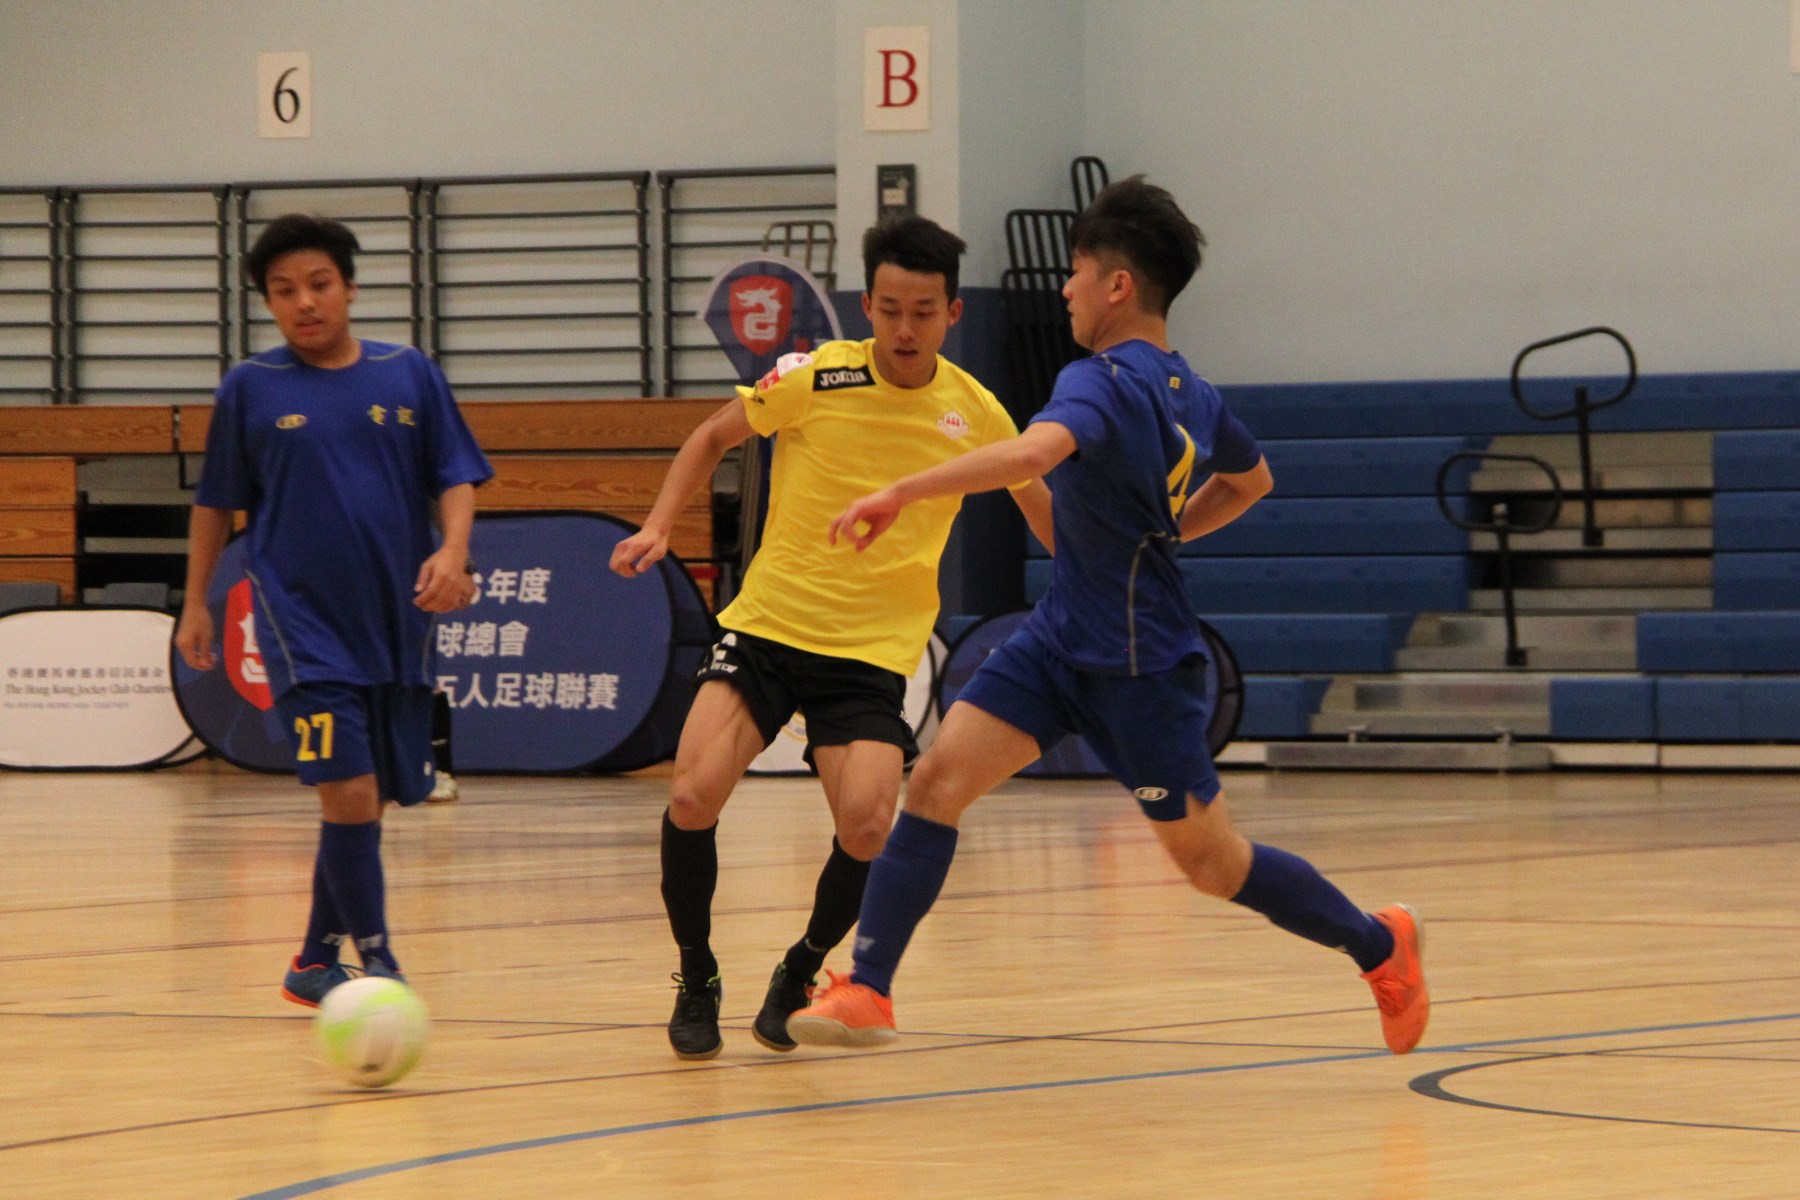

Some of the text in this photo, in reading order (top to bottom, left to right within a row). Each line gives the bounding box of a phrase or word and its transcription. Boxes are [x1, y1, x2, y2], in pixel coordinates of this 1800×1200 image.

[273, 66, 300, 124] 6
[877, 49, 918, 108] B
[294, 713, 334, 761] 27
